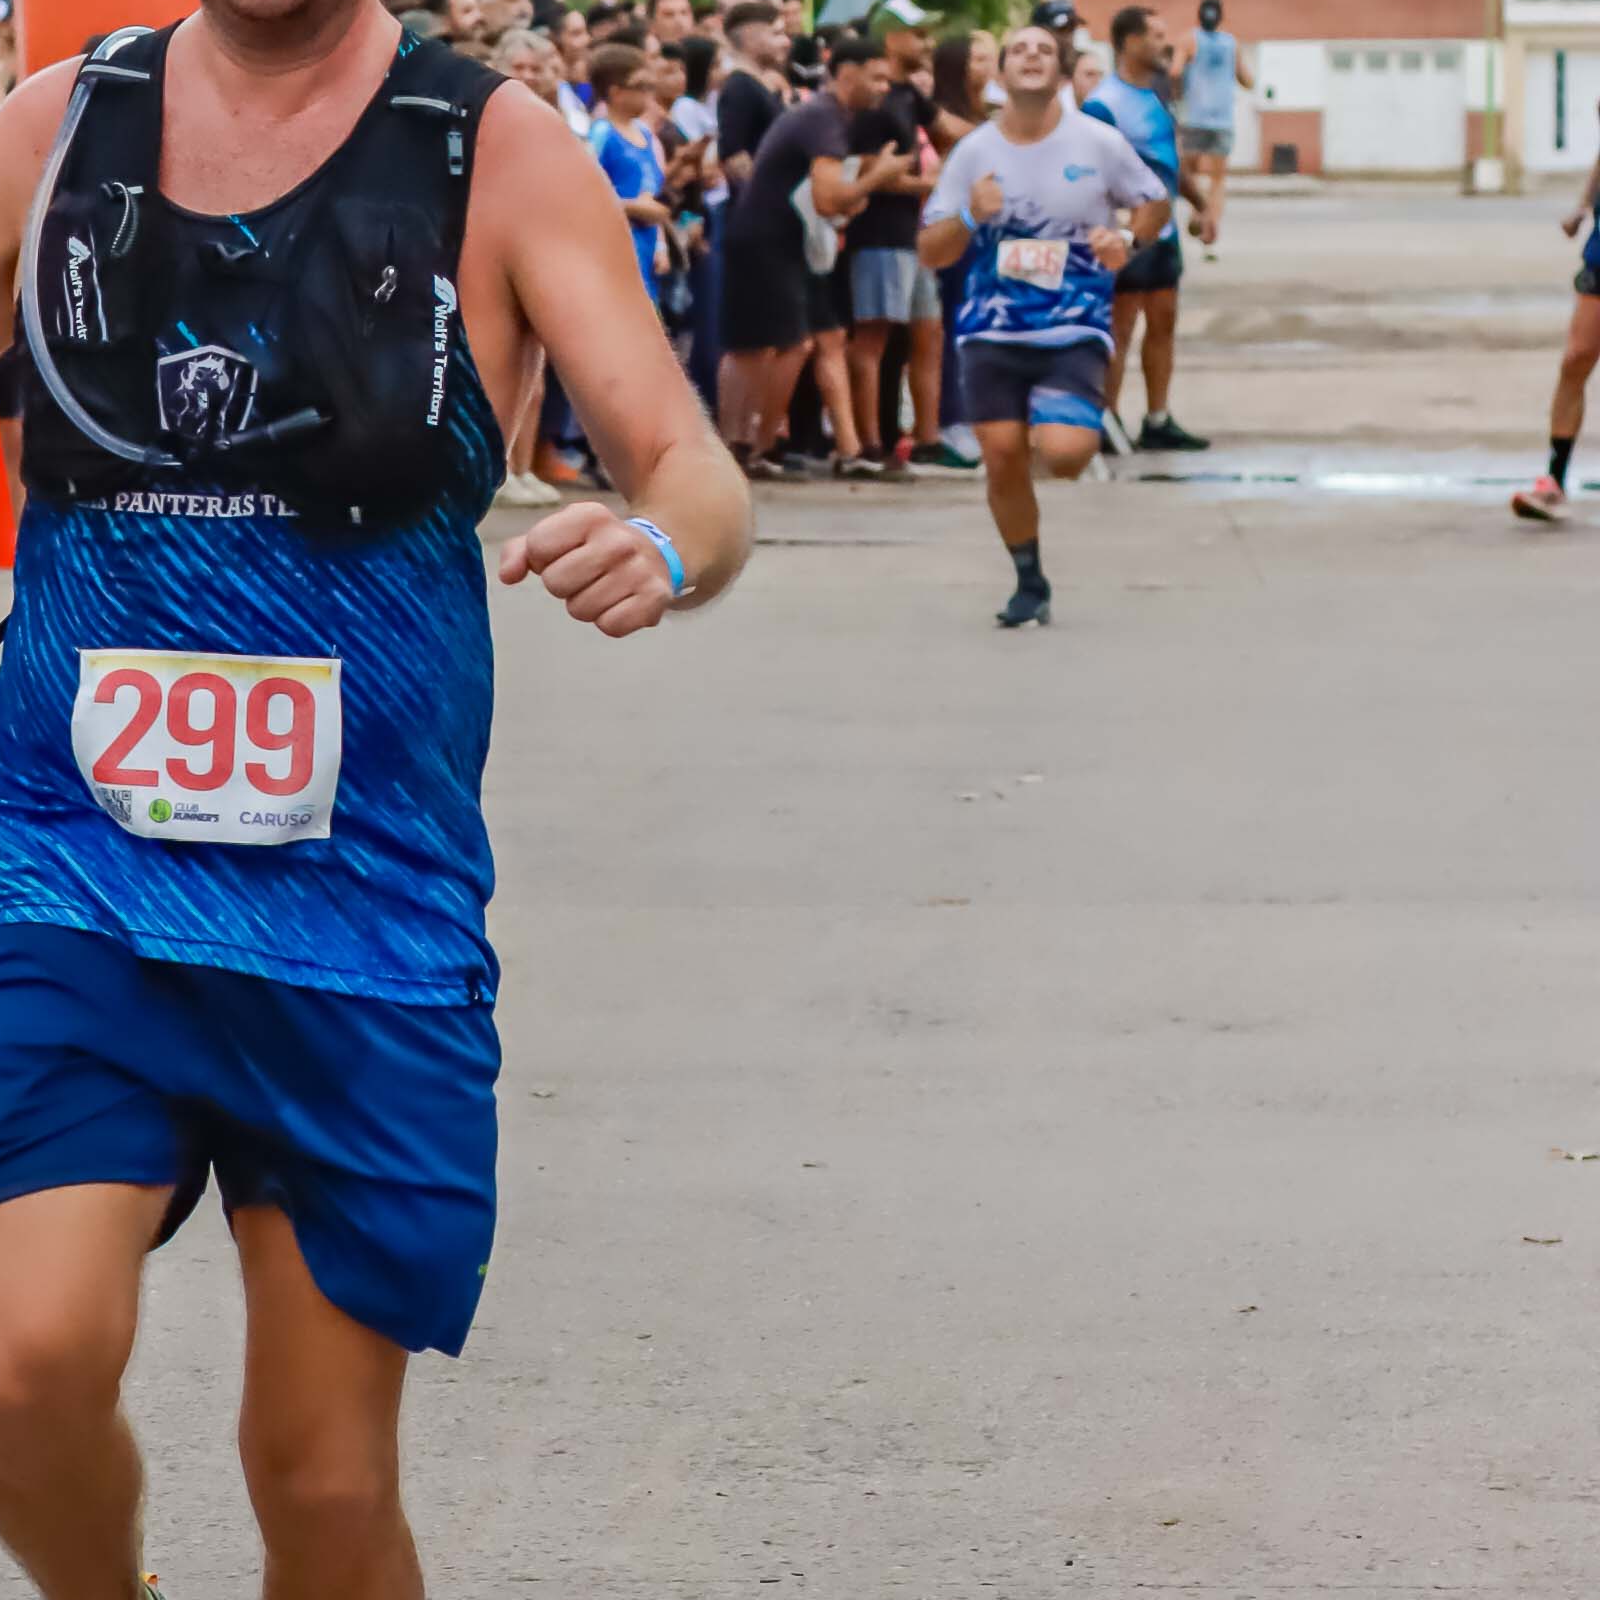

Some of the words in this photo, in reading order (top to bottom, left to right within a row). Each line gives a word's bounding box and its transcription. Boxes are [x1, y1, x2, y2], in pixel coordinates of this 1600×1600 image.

[433, 303, 449, 352] Wolf's
[426, 354, 449, 426] Territory
[114, 492, 256, 518] PANTERAS
[92, 668, 316, 796] 299
[239, 810, 313, 828] CARUSO
